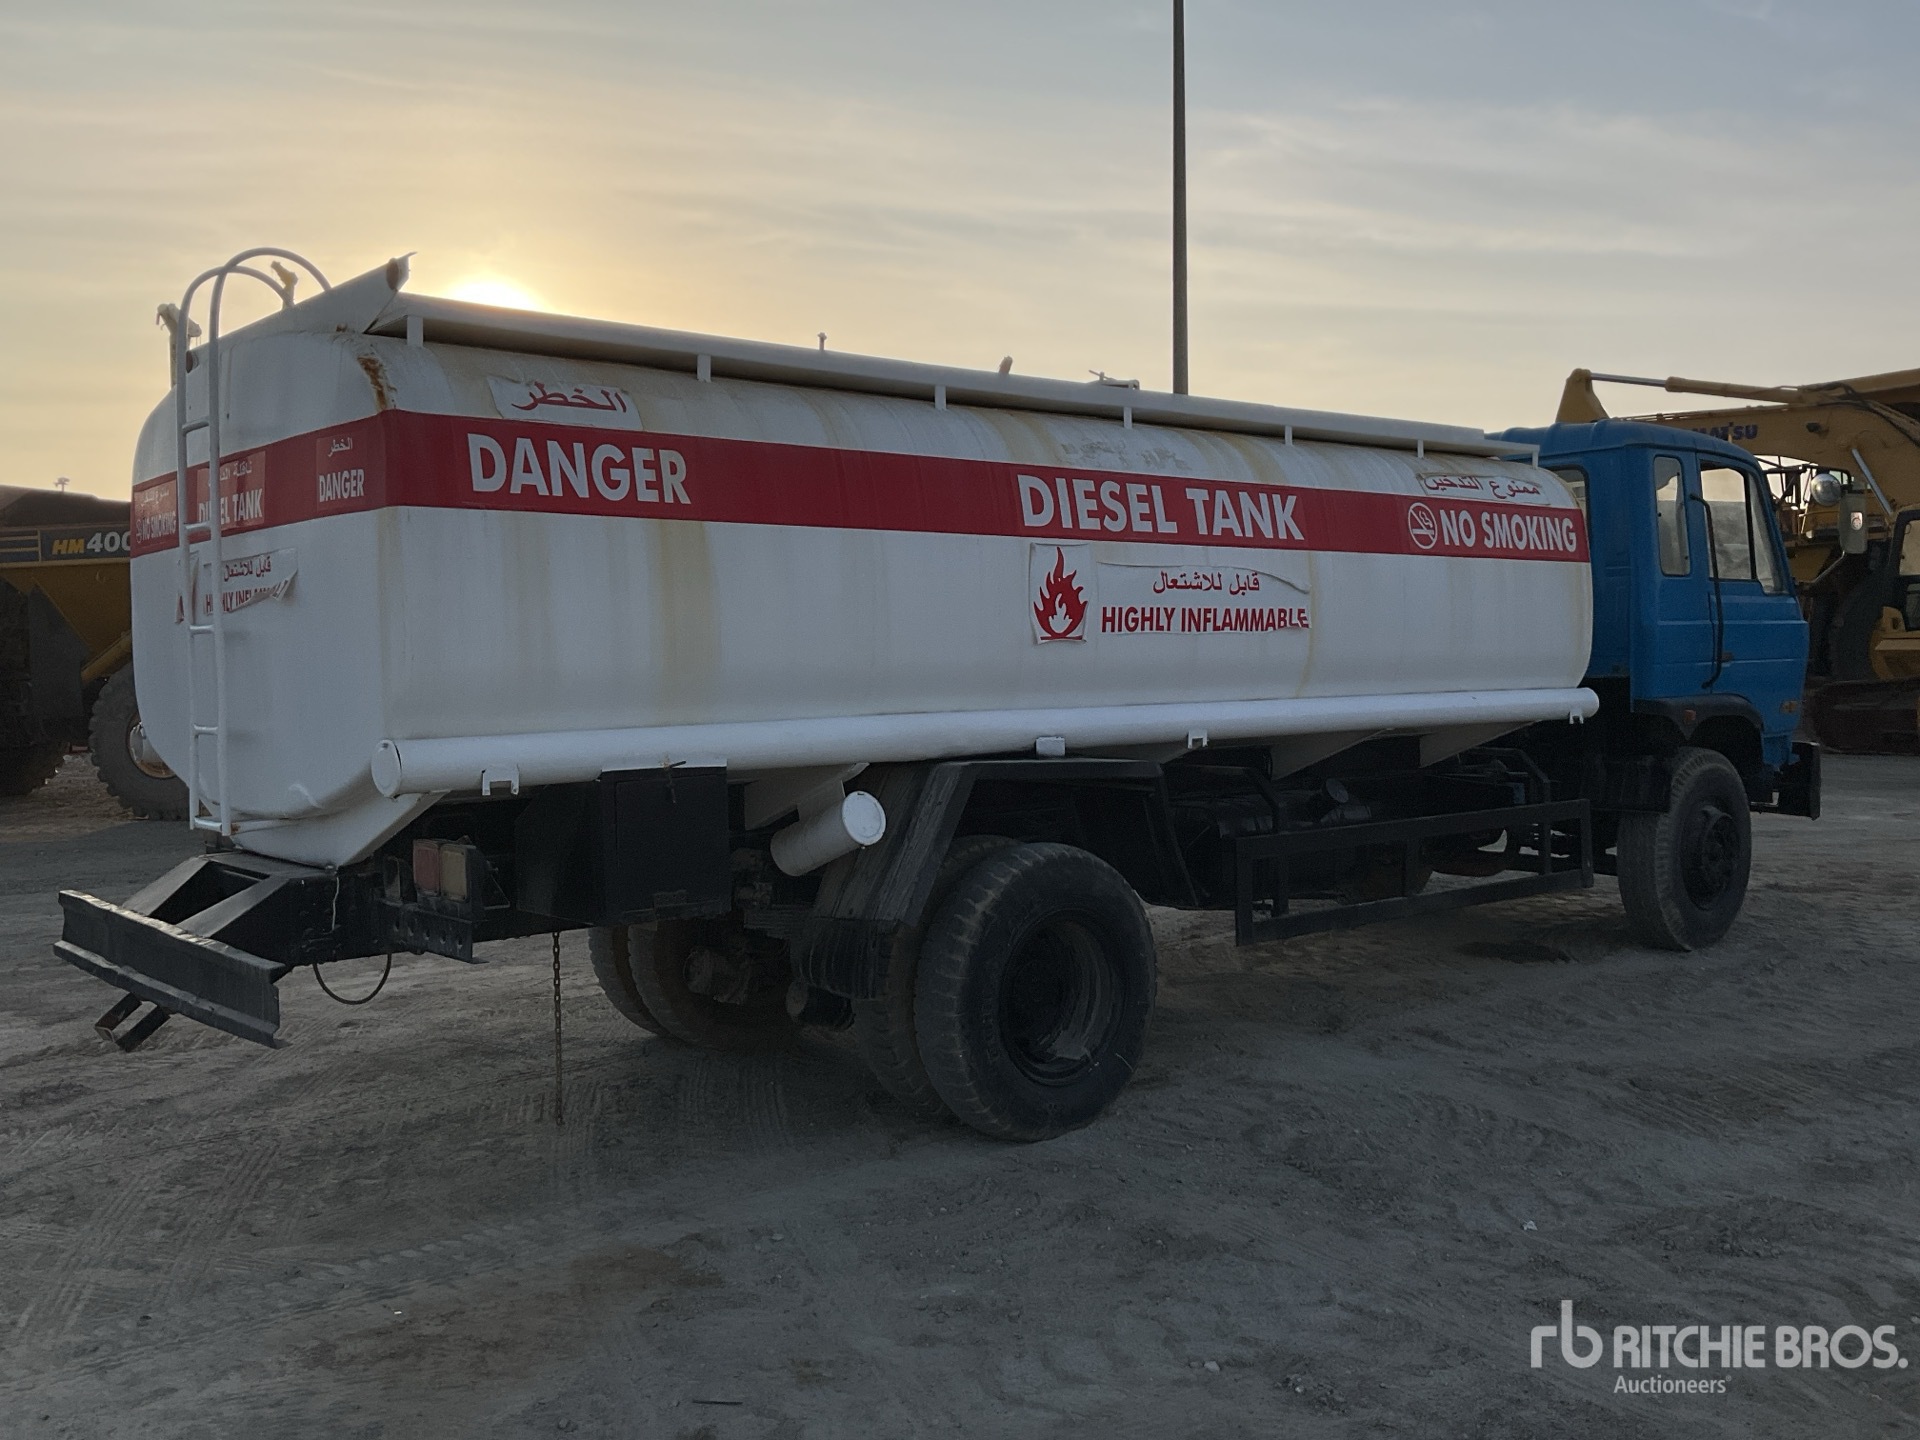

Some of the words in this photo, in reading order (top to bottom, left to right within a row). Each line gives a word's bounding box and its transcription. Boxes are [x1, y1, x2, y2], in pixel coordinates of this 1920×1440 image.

[511, 381, 627, 413] الخطر
[328, 436, 353, 458] الخطر
[467, 433, 691, 504] DANGER
[319, 469, 365, 502] DANGER
[1488, 479, 1540, 499] ممنوع
[198, 496, 230, 525] DIEL
[232, 488, 263, 521] TANK
[1017, 474, 1178, 533] DIESEL
[1186, 488, 1305, 540] TANK
[1439, 510, 1476, 547] NO
[1481, 511, 1577, 552] SMOKING
[1153, 571, 1222, 593] للاشتعال
[1228, 571, 1260, 595] قابل
[1101, 606, 1175, 633] HIGHLY
[1181, 607, 1310, 632] INFLAMMABLE
